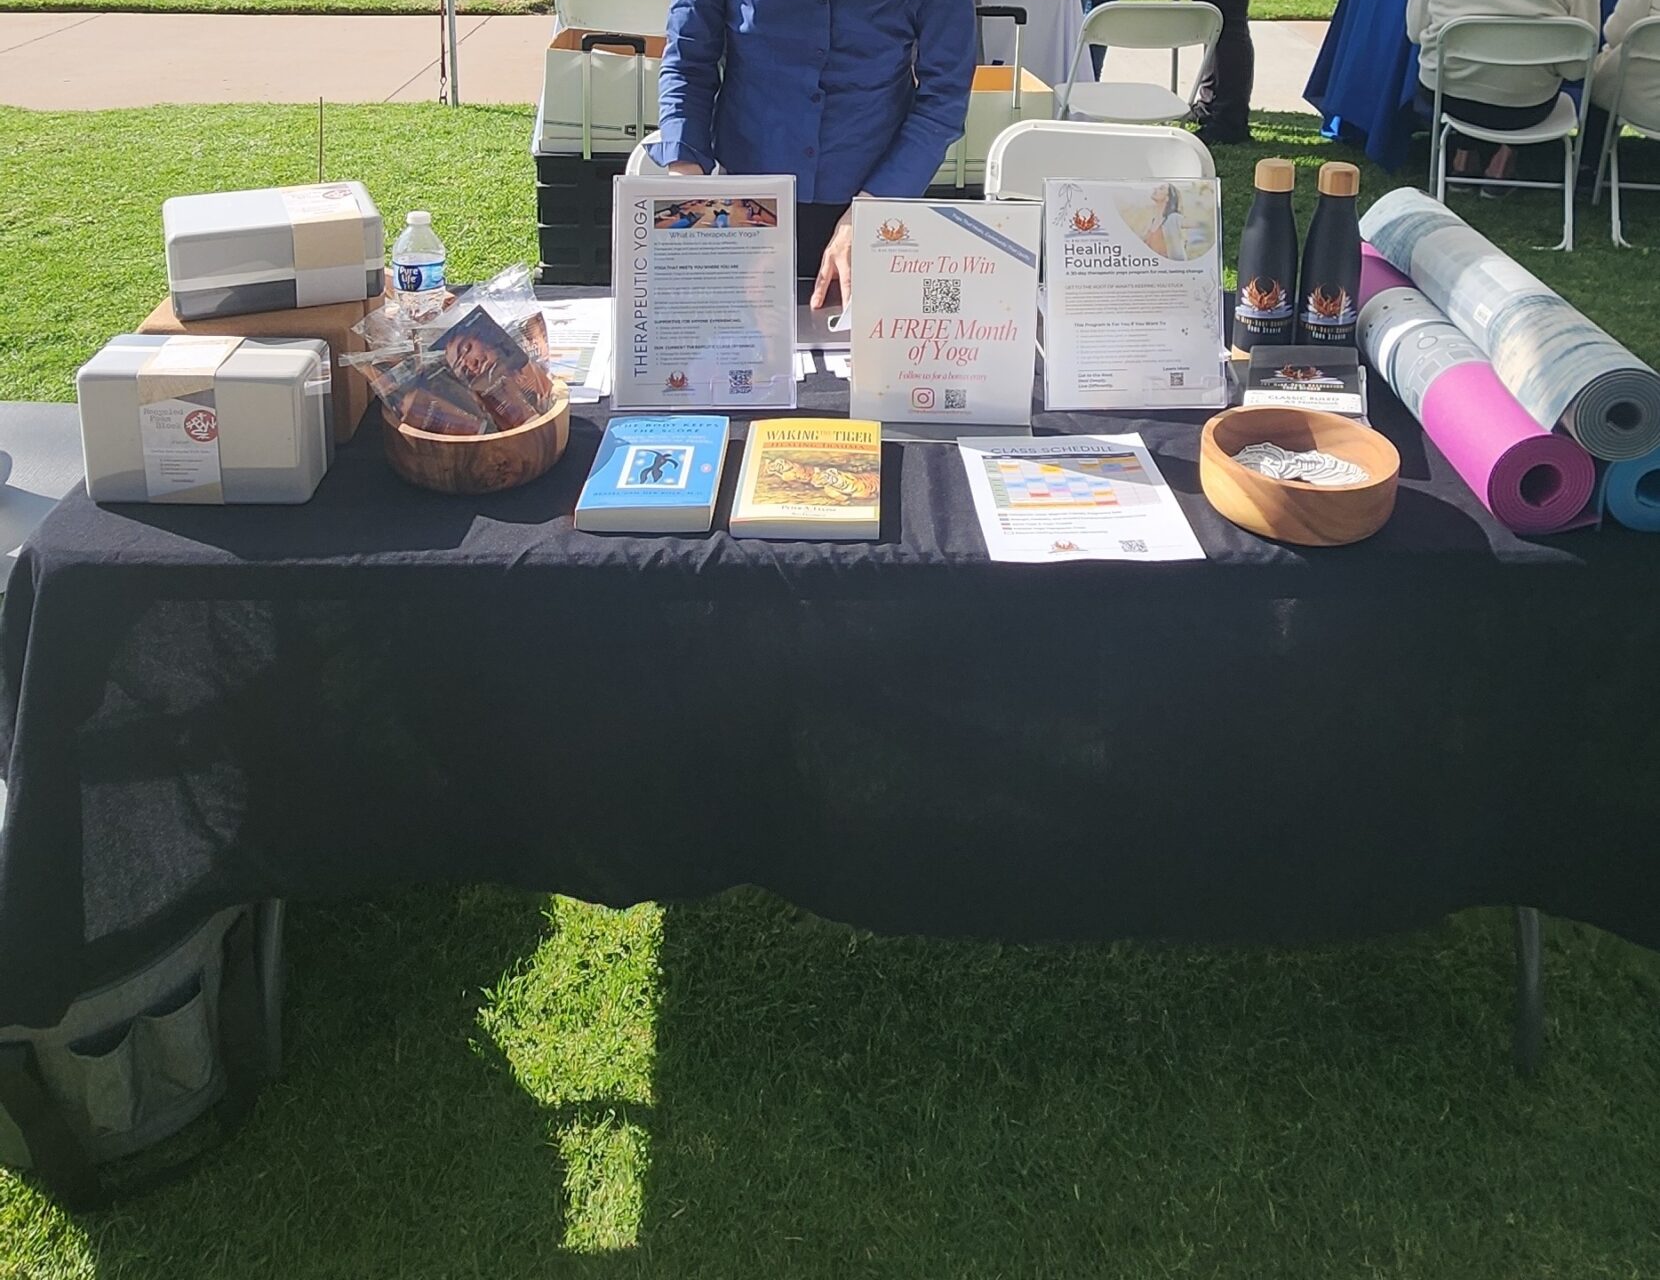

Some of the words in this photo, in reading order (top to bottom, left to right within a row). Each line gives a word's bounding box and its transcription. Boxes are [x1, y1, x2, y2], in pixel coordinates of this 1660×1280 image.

[633, 199, 648, 251] YOGA
[697, 231, 736, 239] Therapeutic
[739, 230, 760, 238] Yoga?
[1064, 242, 1121, 257] Healing
[890, 255, 934, 273] Enter
[938, 255, 959, 273] To
[963, 255, 996, 274] Win
[1064, 254, 1159, 268] Foundations
[400, 266, 418, 275] Pure
[401, 273, 417, 284] Life
[633, 257, 648, 377] THERAPEUTIC
[869, 318, 884, 338] A
[890, 318, 952, 340] FREE
[954, 319, 1018, 341] Month
[908, 339, 932, 365] of
[932, 340, 979, 367] Yoga
[898, 371, 921, 380] Follow
[766, 430, 820, 441] WAKING
[833, 430, 873, 443] TIGER
